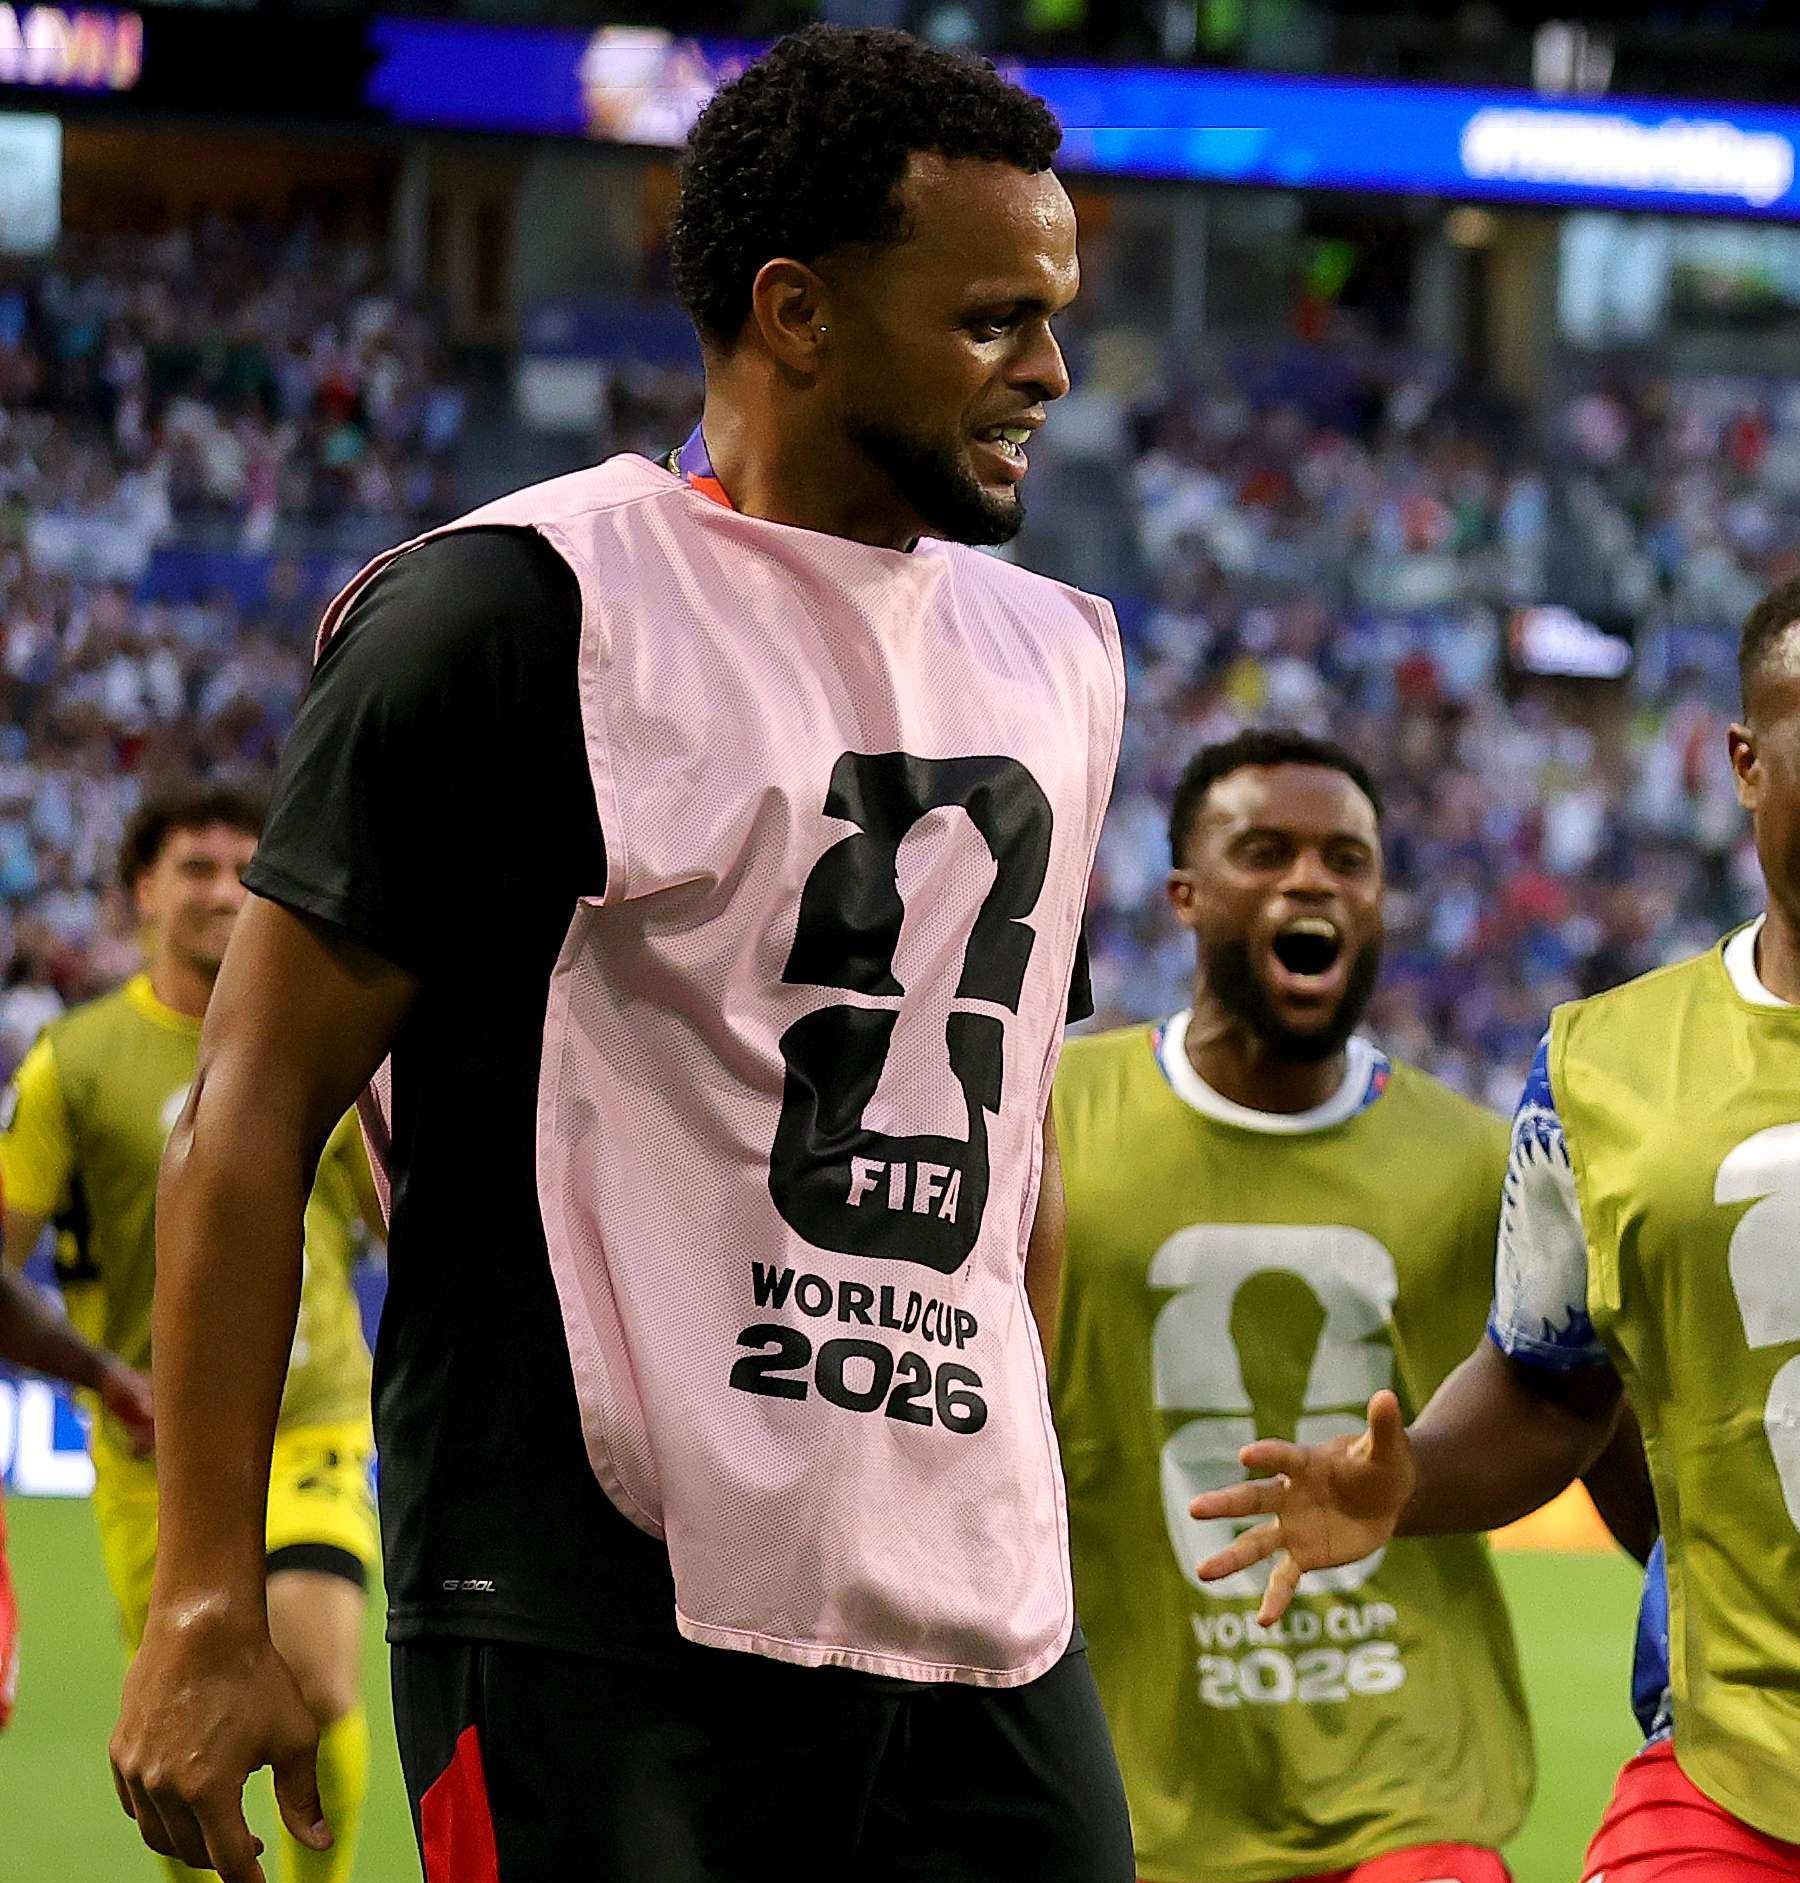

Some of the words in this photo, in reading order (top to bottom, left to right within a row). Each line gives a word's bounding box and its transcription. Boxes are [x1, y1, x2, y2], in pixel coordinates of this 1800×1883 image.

[846, 1156, 961, 1224] FIFA
[752, 1261, 922, 1334] WORLD
[920, 1298, 978, 1350] CUP
[729, 1323, 989, 1435] 2026
[1196, 1640, 1406, 1709] 2026
